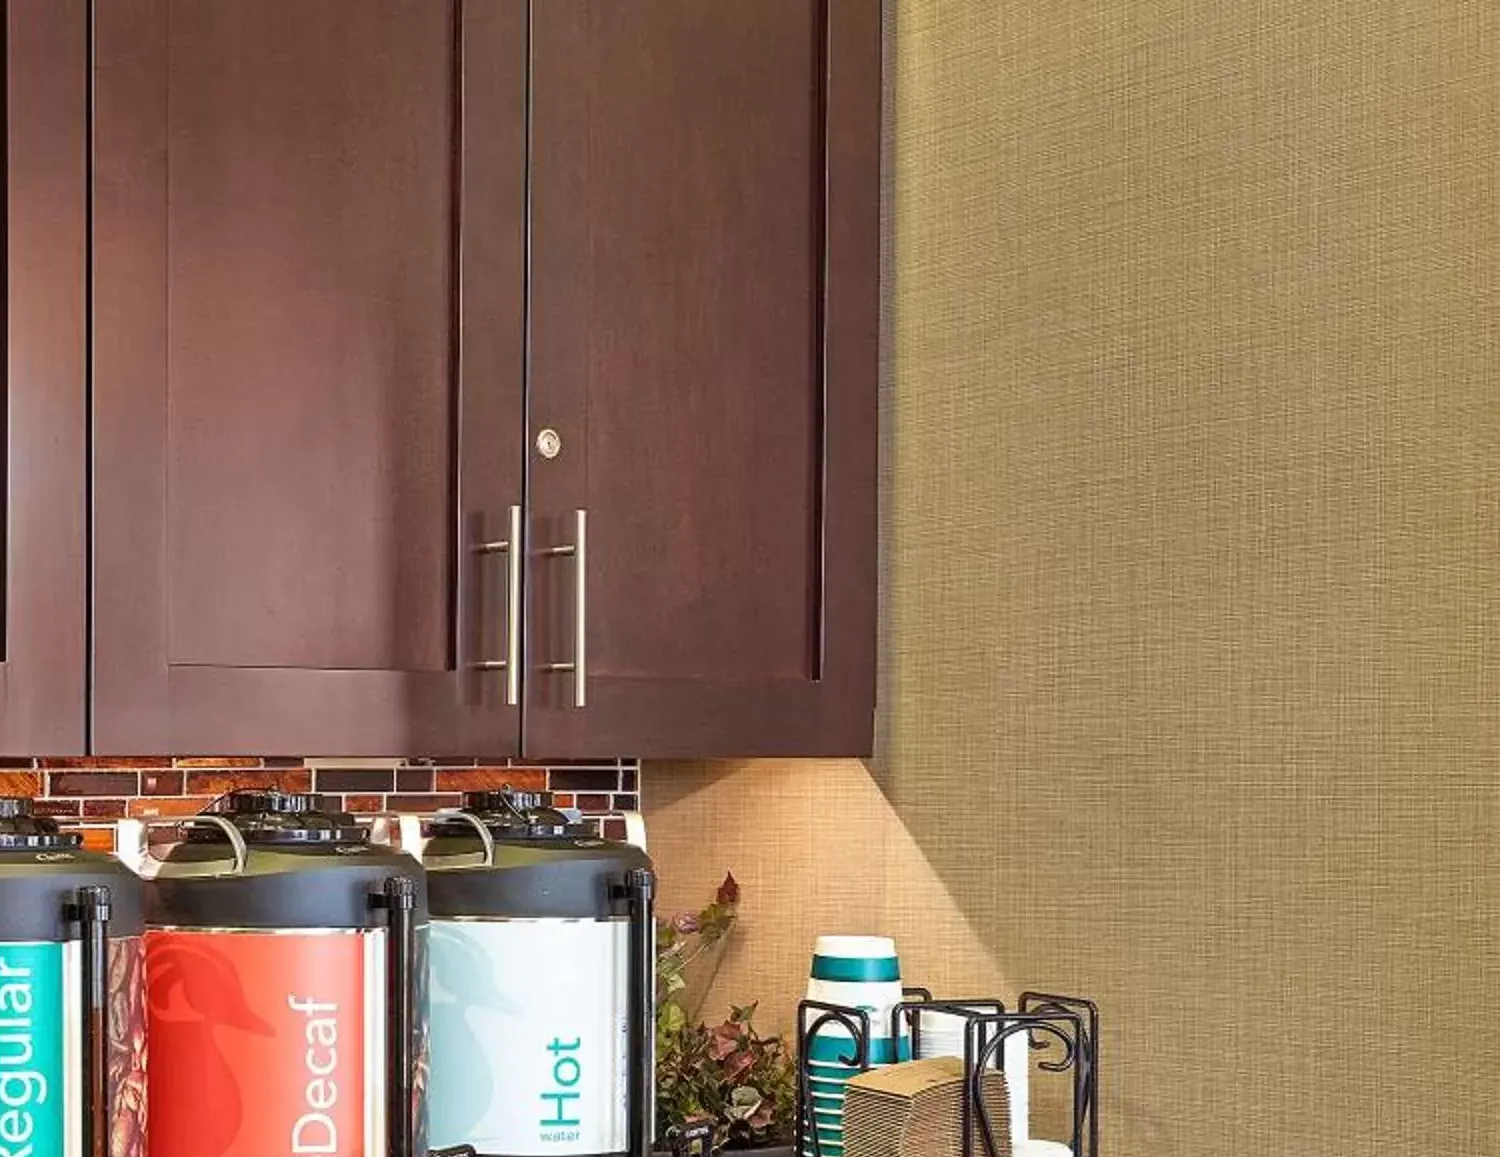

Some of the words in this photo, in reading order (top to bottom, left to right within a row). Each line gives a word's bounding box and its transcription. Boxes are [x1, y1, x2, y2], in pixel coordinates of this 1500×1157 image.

[288, 992, 338, 1153] Decaf
[539, 1036, 581, 1127] Hot
[539, 1130, 581, 1143] water
